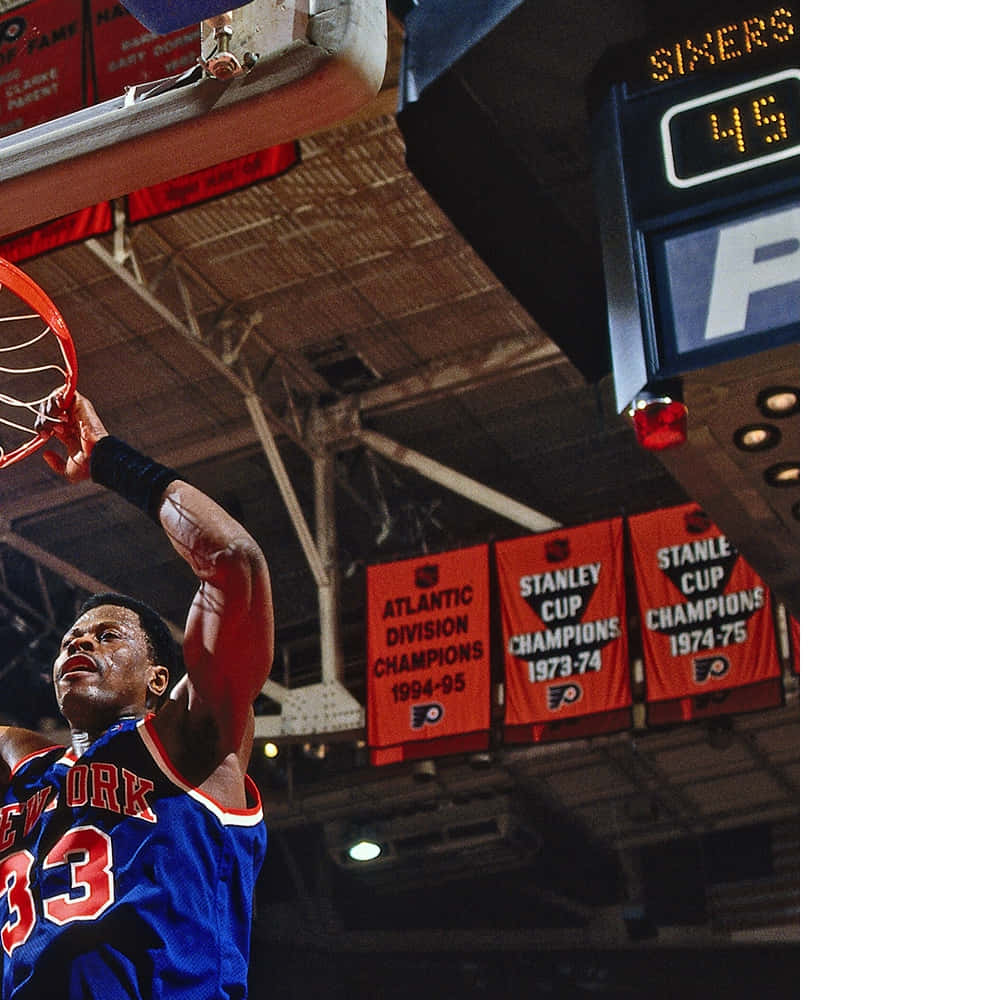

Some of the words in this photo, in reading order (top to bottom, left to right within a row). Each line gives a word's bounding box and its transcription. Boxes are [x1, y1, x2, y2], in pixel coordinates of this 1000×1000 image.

[650, 8, 796, 82] SIXERS
[709, 95, 788, 152] 45
[657, 536, 738, 569] STANLE
[520, 563, 602, 598] STANLEY
[681, 565, 724, 595] CUP
[383, 585, 473, 619] ATLANTIC
[541, 594, 582, 622] CUP
[646, 586, 765, 630] CHAMPIONS
[386, 615, 468, 646] DIVISION
[509, 616, 622, 656] CHAMPIONS
[670, 620, 748, 657] 1974-75
[374, 640, 484, 678] CHAMPIONS
[528, 649, 602, 683] 1973-74
[392, 672, 465, 704] 1994-95
[64, 763, 158, 824] ORK
